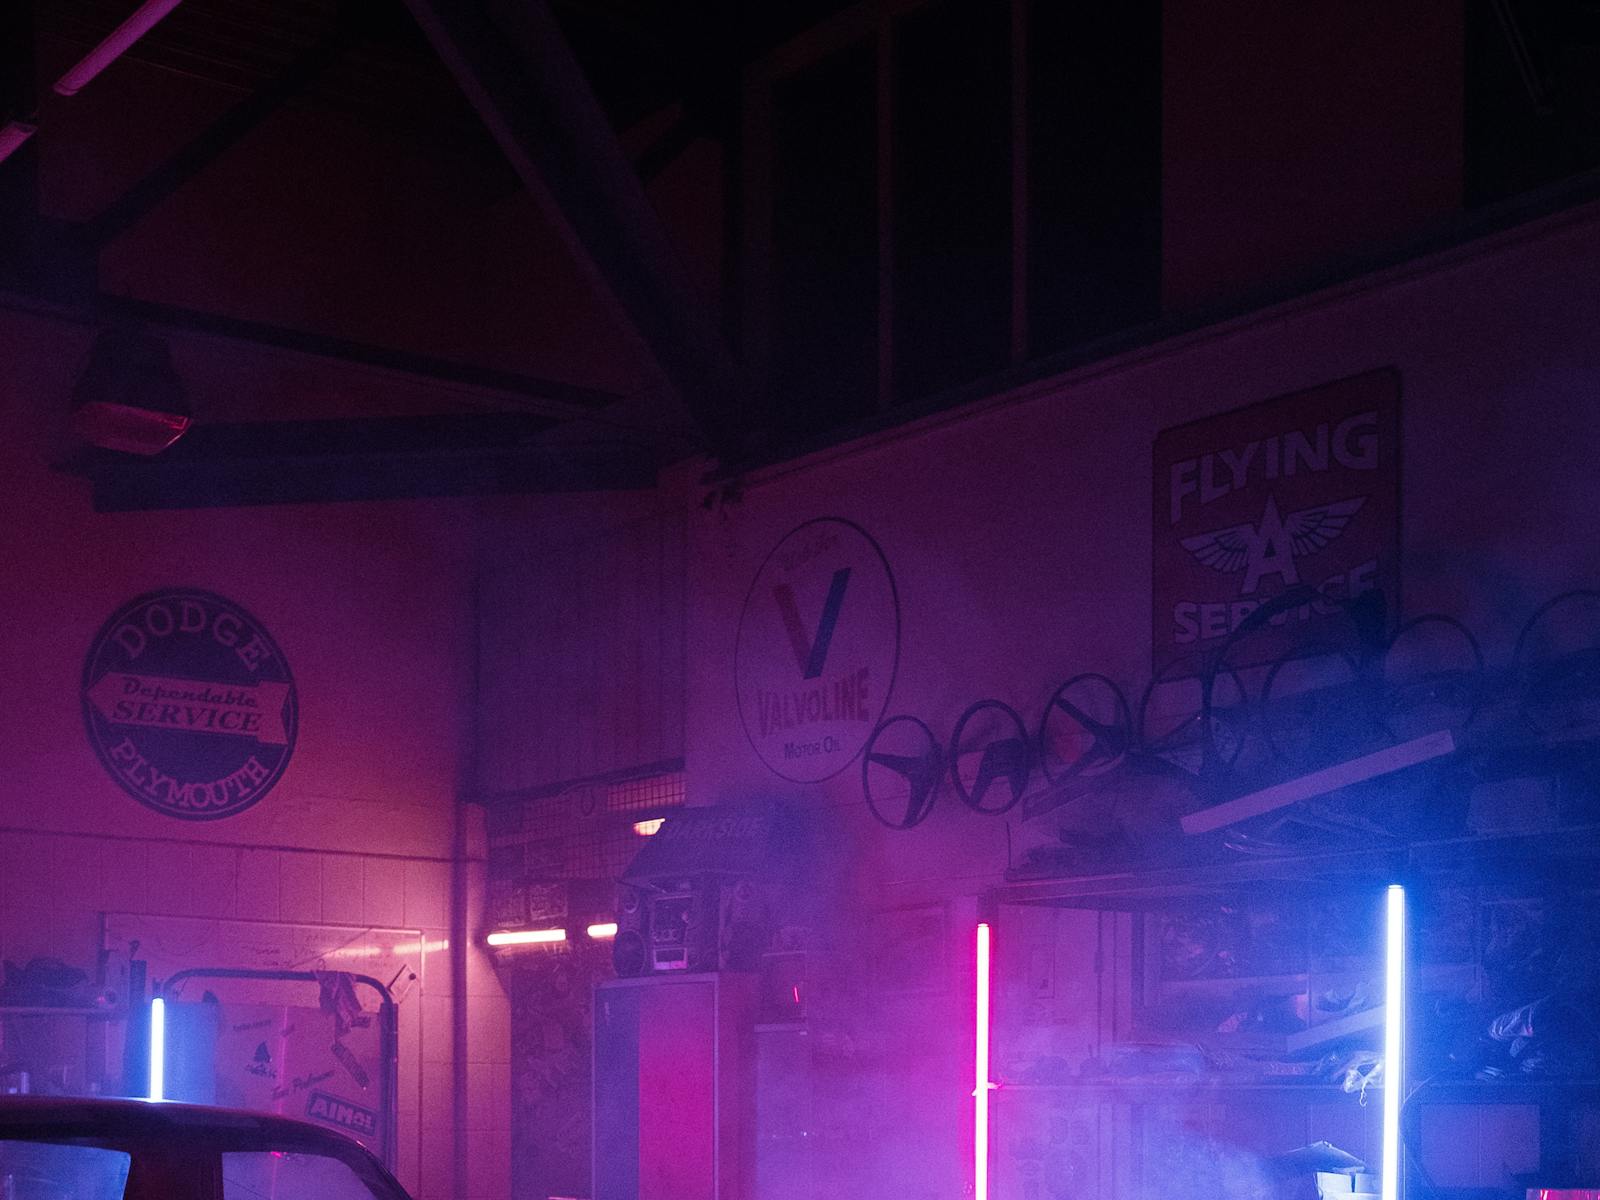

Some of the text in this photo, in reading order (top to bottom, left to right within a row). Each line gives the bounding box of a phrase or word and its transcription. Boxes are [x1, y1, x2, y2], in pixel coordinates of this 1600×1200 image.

[1170, 410, 1378, 527] FLYING
[112, 600, 272, 671] DODGE
[112, 700, 263, 732] SERVICE
[122, 677, 258, 707] Dependable
[756, 666, 870, 739] VALVOLINE
[109, 737, 270, 808] PLYMOUTH
